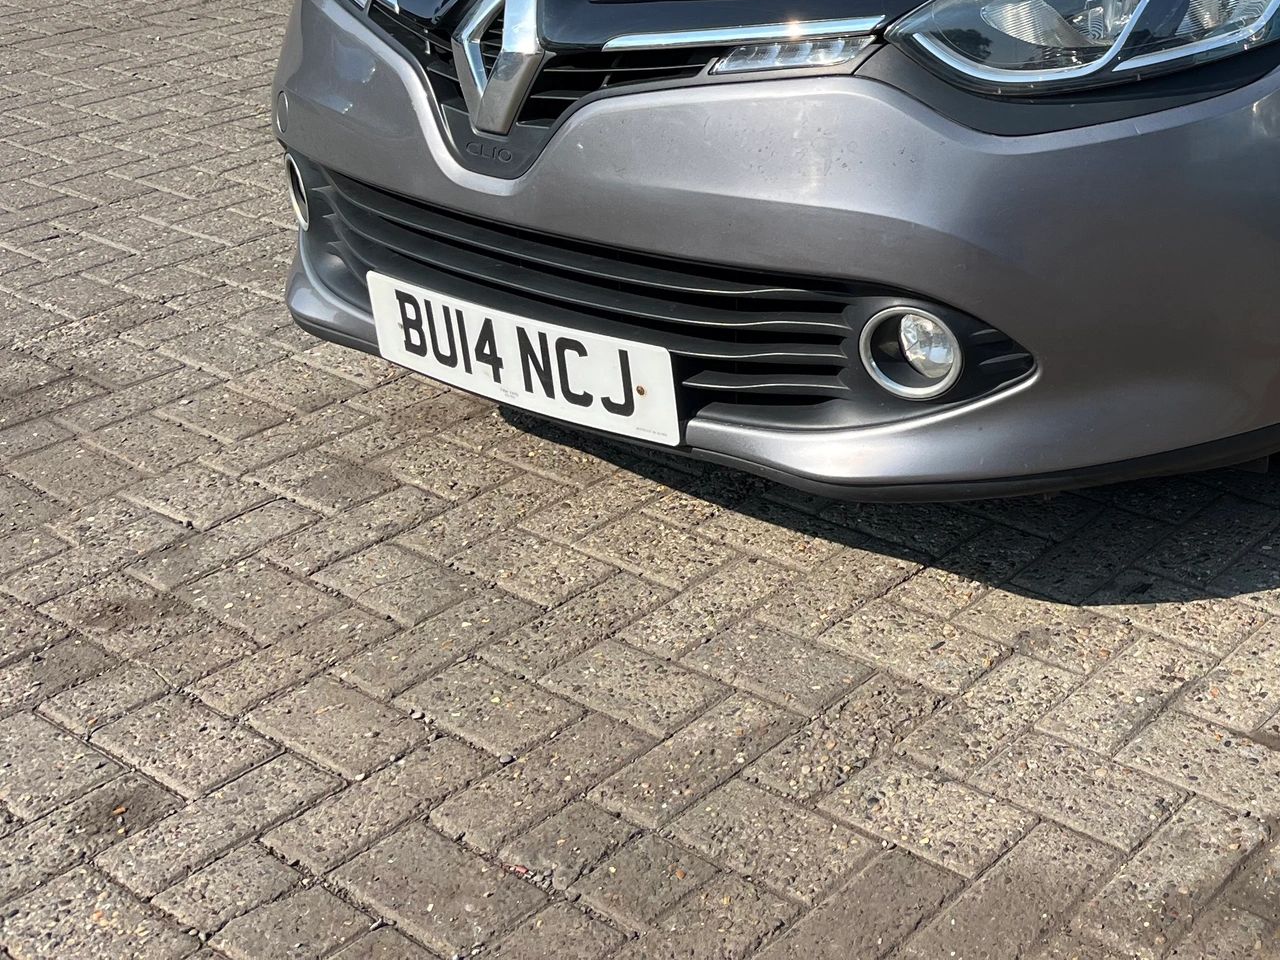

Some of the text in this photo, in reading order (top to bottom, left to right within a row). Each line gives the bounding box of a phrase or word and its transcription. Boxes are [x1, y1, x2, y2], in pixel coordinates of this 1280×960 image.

[465, 141, 512, 164] CLIO
[394, 289, 635, 417] BU14 NCJ
